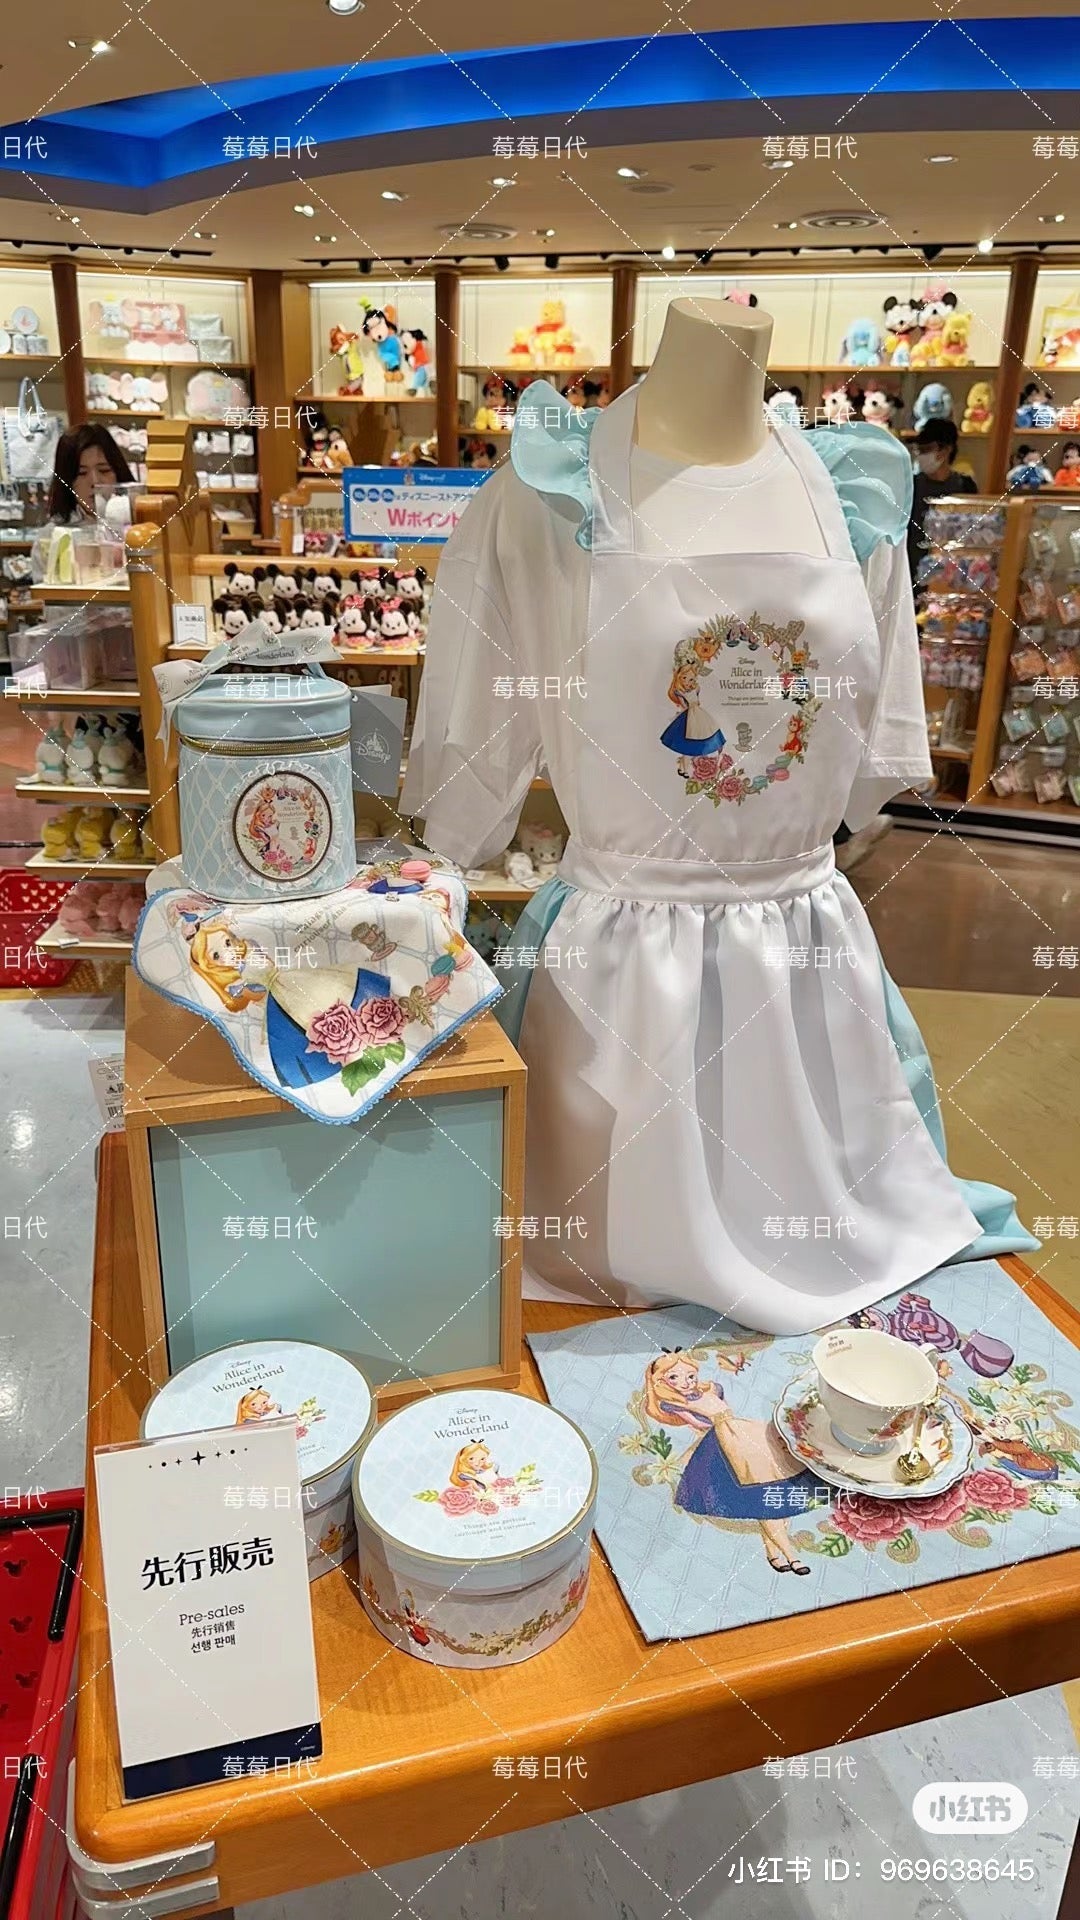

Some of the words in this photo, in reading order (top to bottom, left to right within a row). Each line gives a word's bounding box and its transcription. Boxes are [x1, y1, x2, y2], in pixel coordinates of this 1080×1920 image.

[387, 508, 461, 528] Wポイント
[731, 667, 752, 677] Alice
[754, 667, 762, 677] in
[353, 741, 391, 764] Disney
[212, 1365, 285, 1394] Wonderland
[224, 1367, 251, 1381] Alice
[254, 1363, 266, 1373] in
[434, 1421, 510, 1440] Wonderland
[448, 1416, 477, 1427] Alice
[479, 1414, 491, 1424] in
[141, 1537, 274, 1591] 先行販売
[179, 1603, 245, 1626] Pre-sales
[191, 1619, 235, 1639] 先行销售
[191, 1640, 212, 1654] 선행
[214, 1634, 236, 1649] 판매
